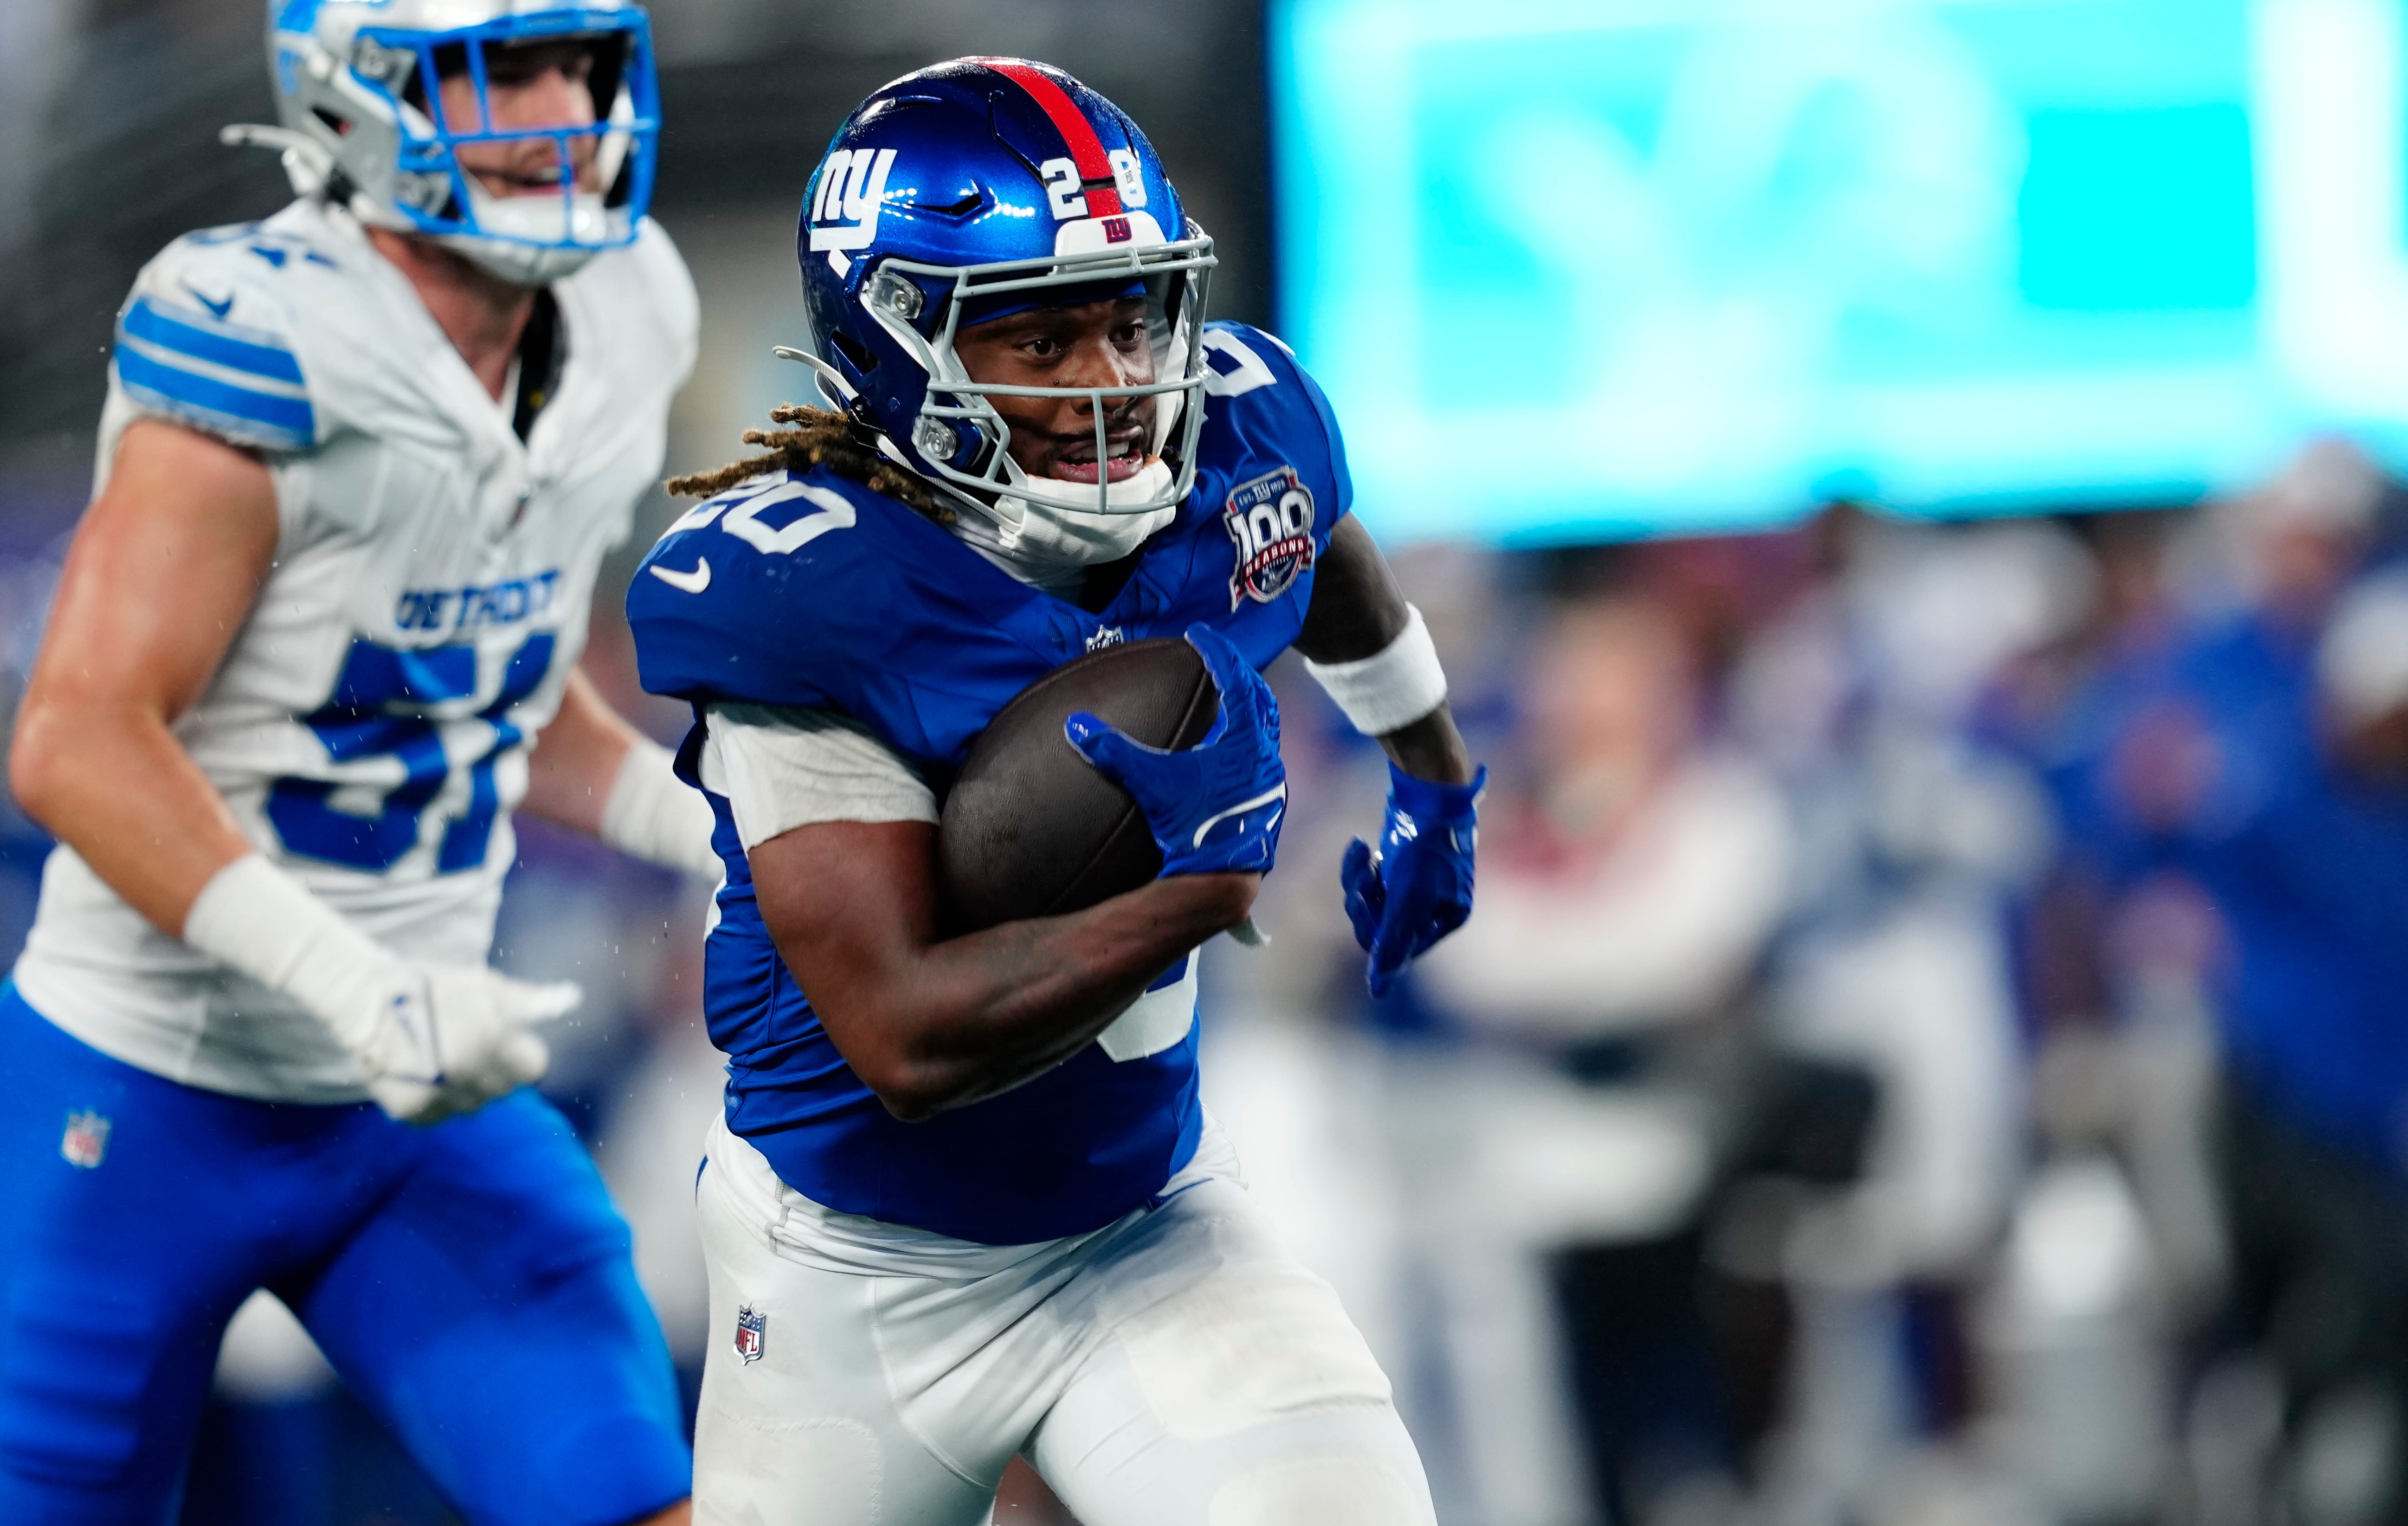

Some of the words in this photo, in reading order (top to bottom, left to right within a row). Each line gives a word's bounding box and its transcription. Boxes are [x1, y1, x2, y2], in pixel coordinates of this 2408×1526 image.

[1230, 489, 1313, 566] 100
[1246, 538, 1305, 578] SEASONS
[738, 1327, 758, 1353] NFL
